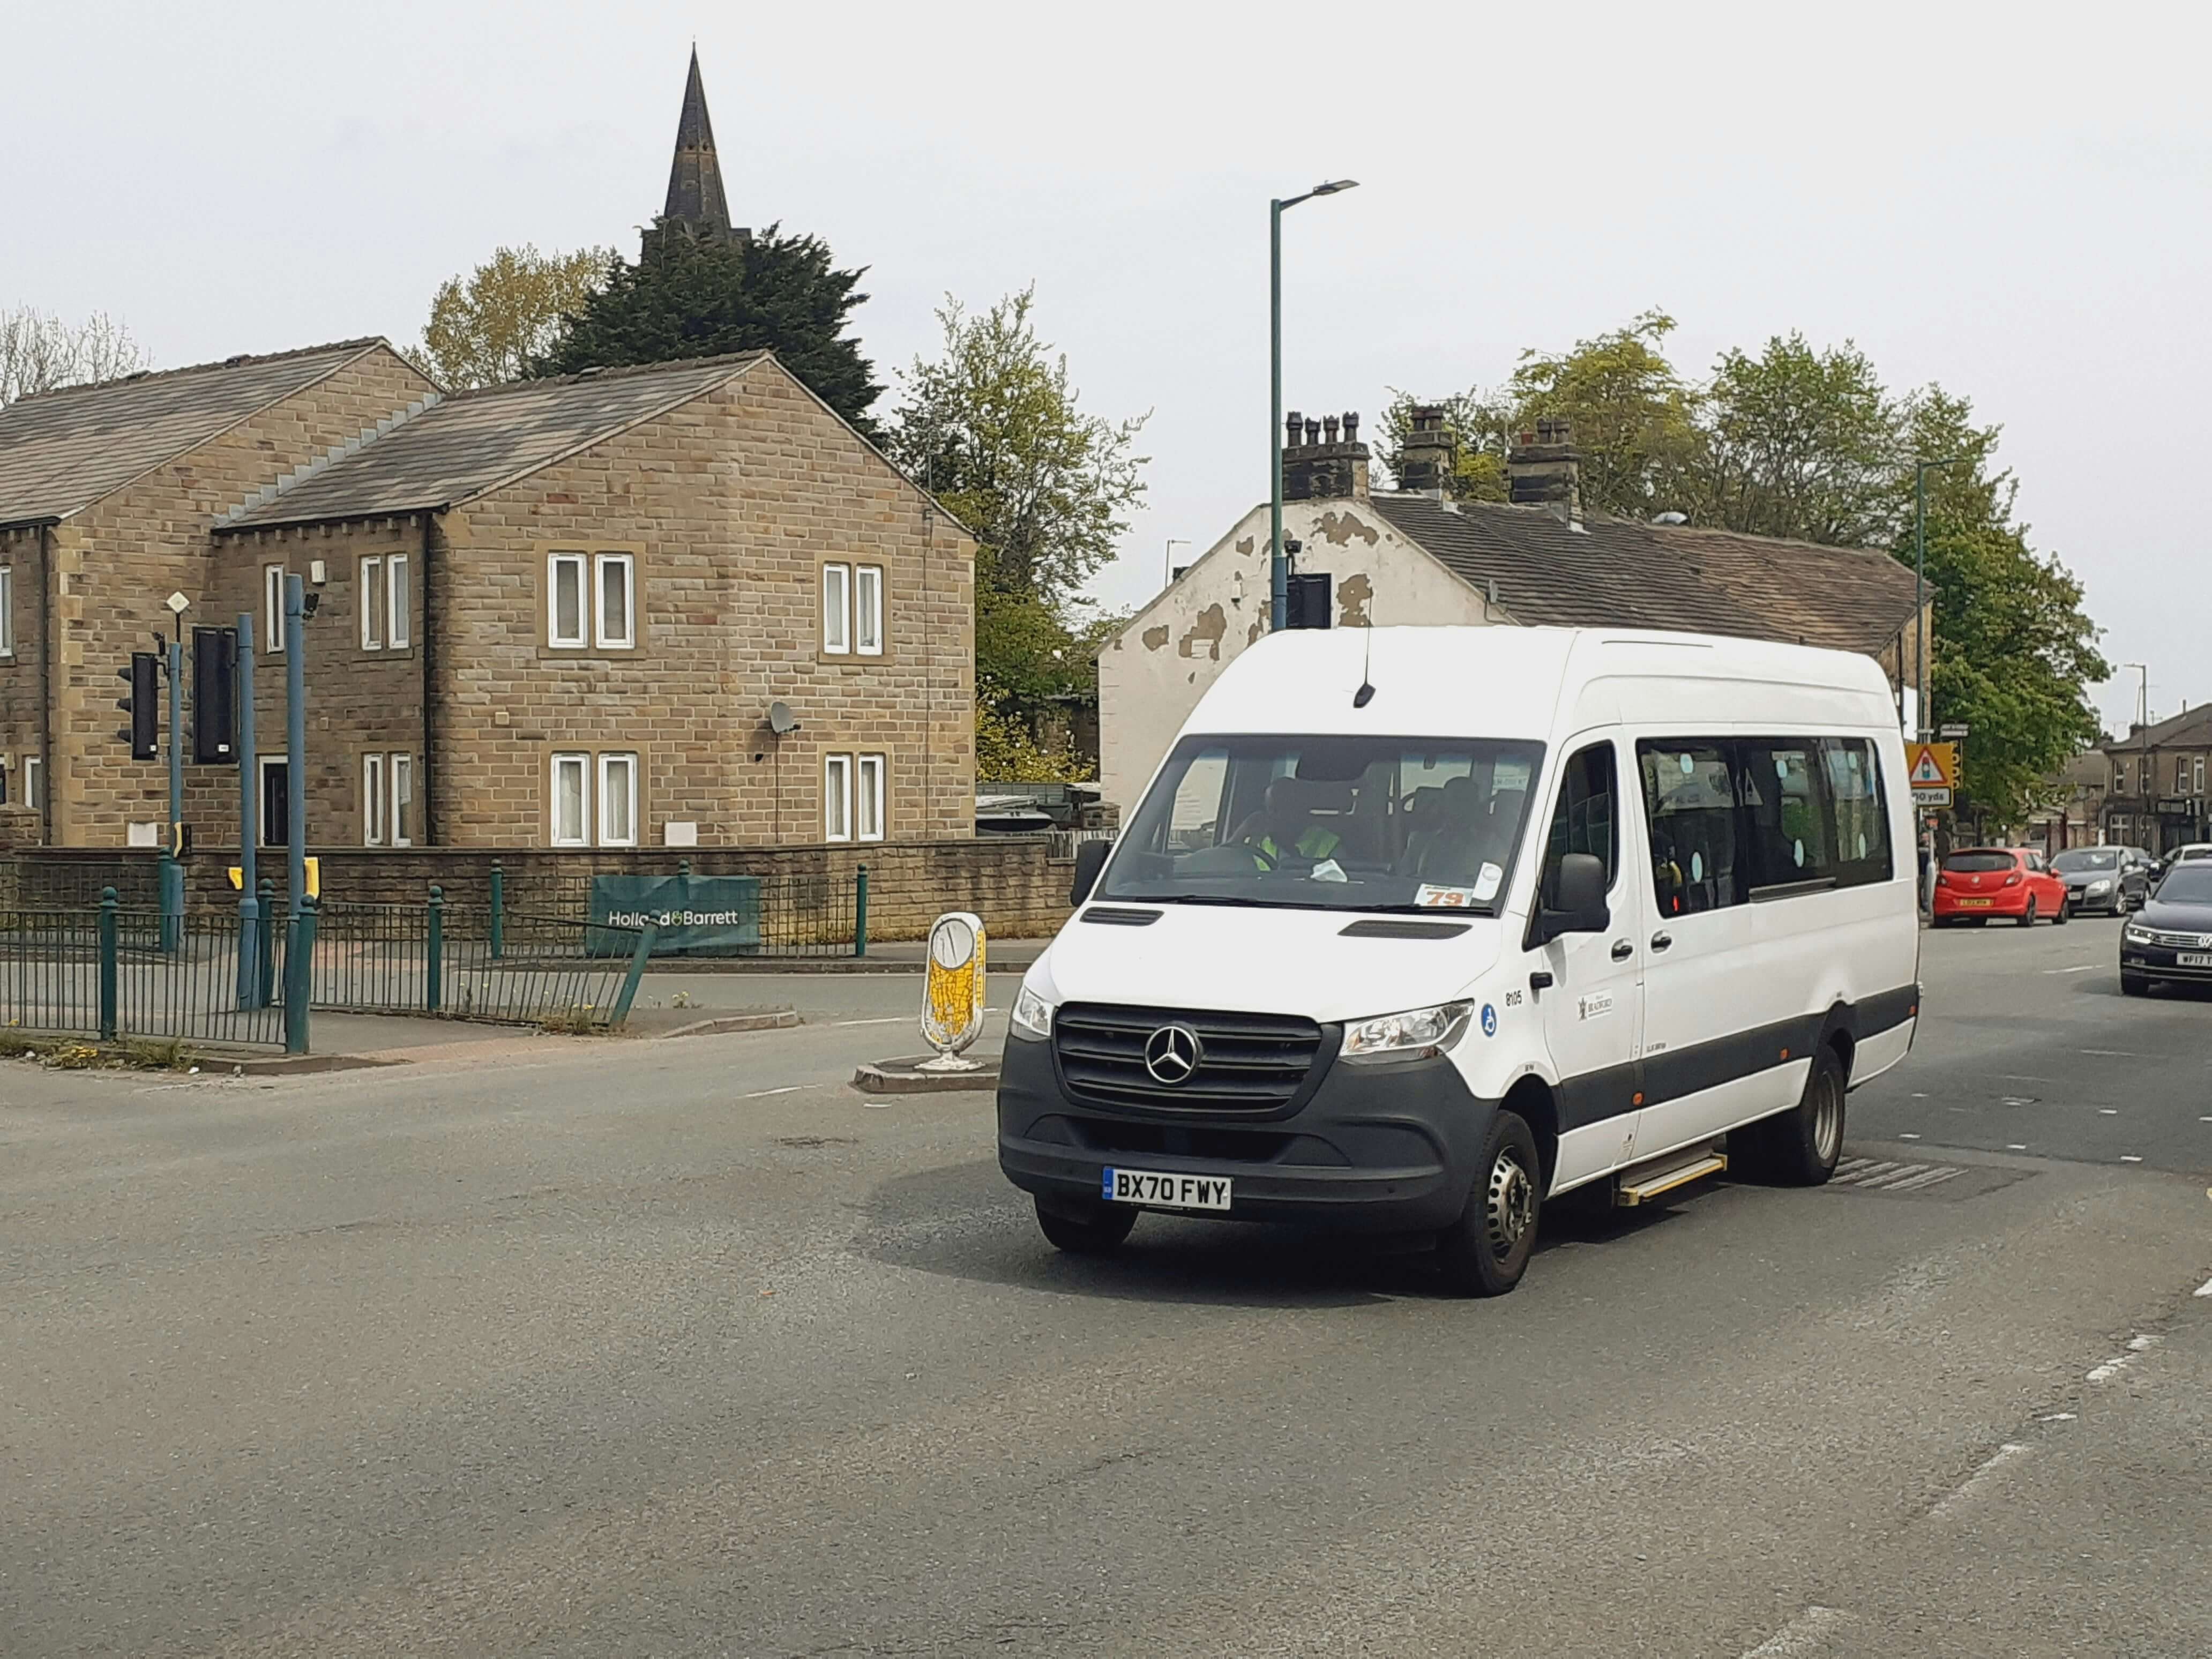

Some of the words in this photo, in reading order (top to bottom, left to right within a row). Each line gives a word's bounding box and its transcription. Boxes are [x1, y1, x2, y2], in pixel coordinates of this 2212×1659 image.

[1929, 792, 1944, 802] yds
[1426, 891, 1464, 906] 79
[609, 910, 670, 926] Hollad
[683, 910, 738, 925] Barrett
[1506, 990, 1522, 1007] 8105
[1117, 1174, 1174, 1200] BX70
[1180, 1179, 1226, 1205] FWY
